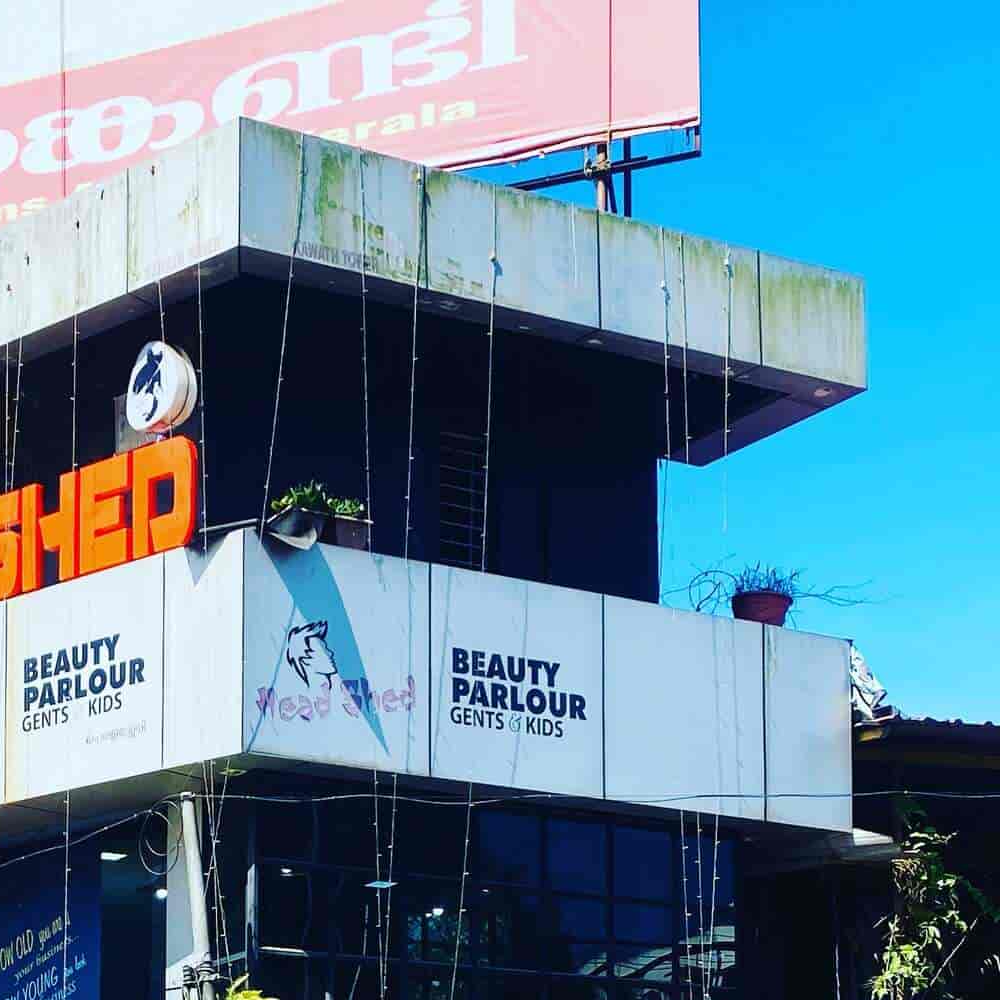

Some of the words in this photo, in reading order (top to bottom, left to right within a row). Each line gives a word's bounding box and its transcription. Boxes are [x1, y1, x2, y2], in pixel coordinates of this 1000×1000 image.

[316, 100, 476, 146] erala
[23, 633, 121, 684] BEAUTY
[451, 647, 561, 688] BEAUTY
[23, 657, 146, 713] PARLOUR
[451, 676, 588, 721] PARLOUR
[22, 706, 69, 732] GENTS
[88, 692, 123, 718] KIDS
[450, 706, 505, 731] GENTS
[525, 717, 564, 738] KIDS
[15, 929, 35, 960] OLD
